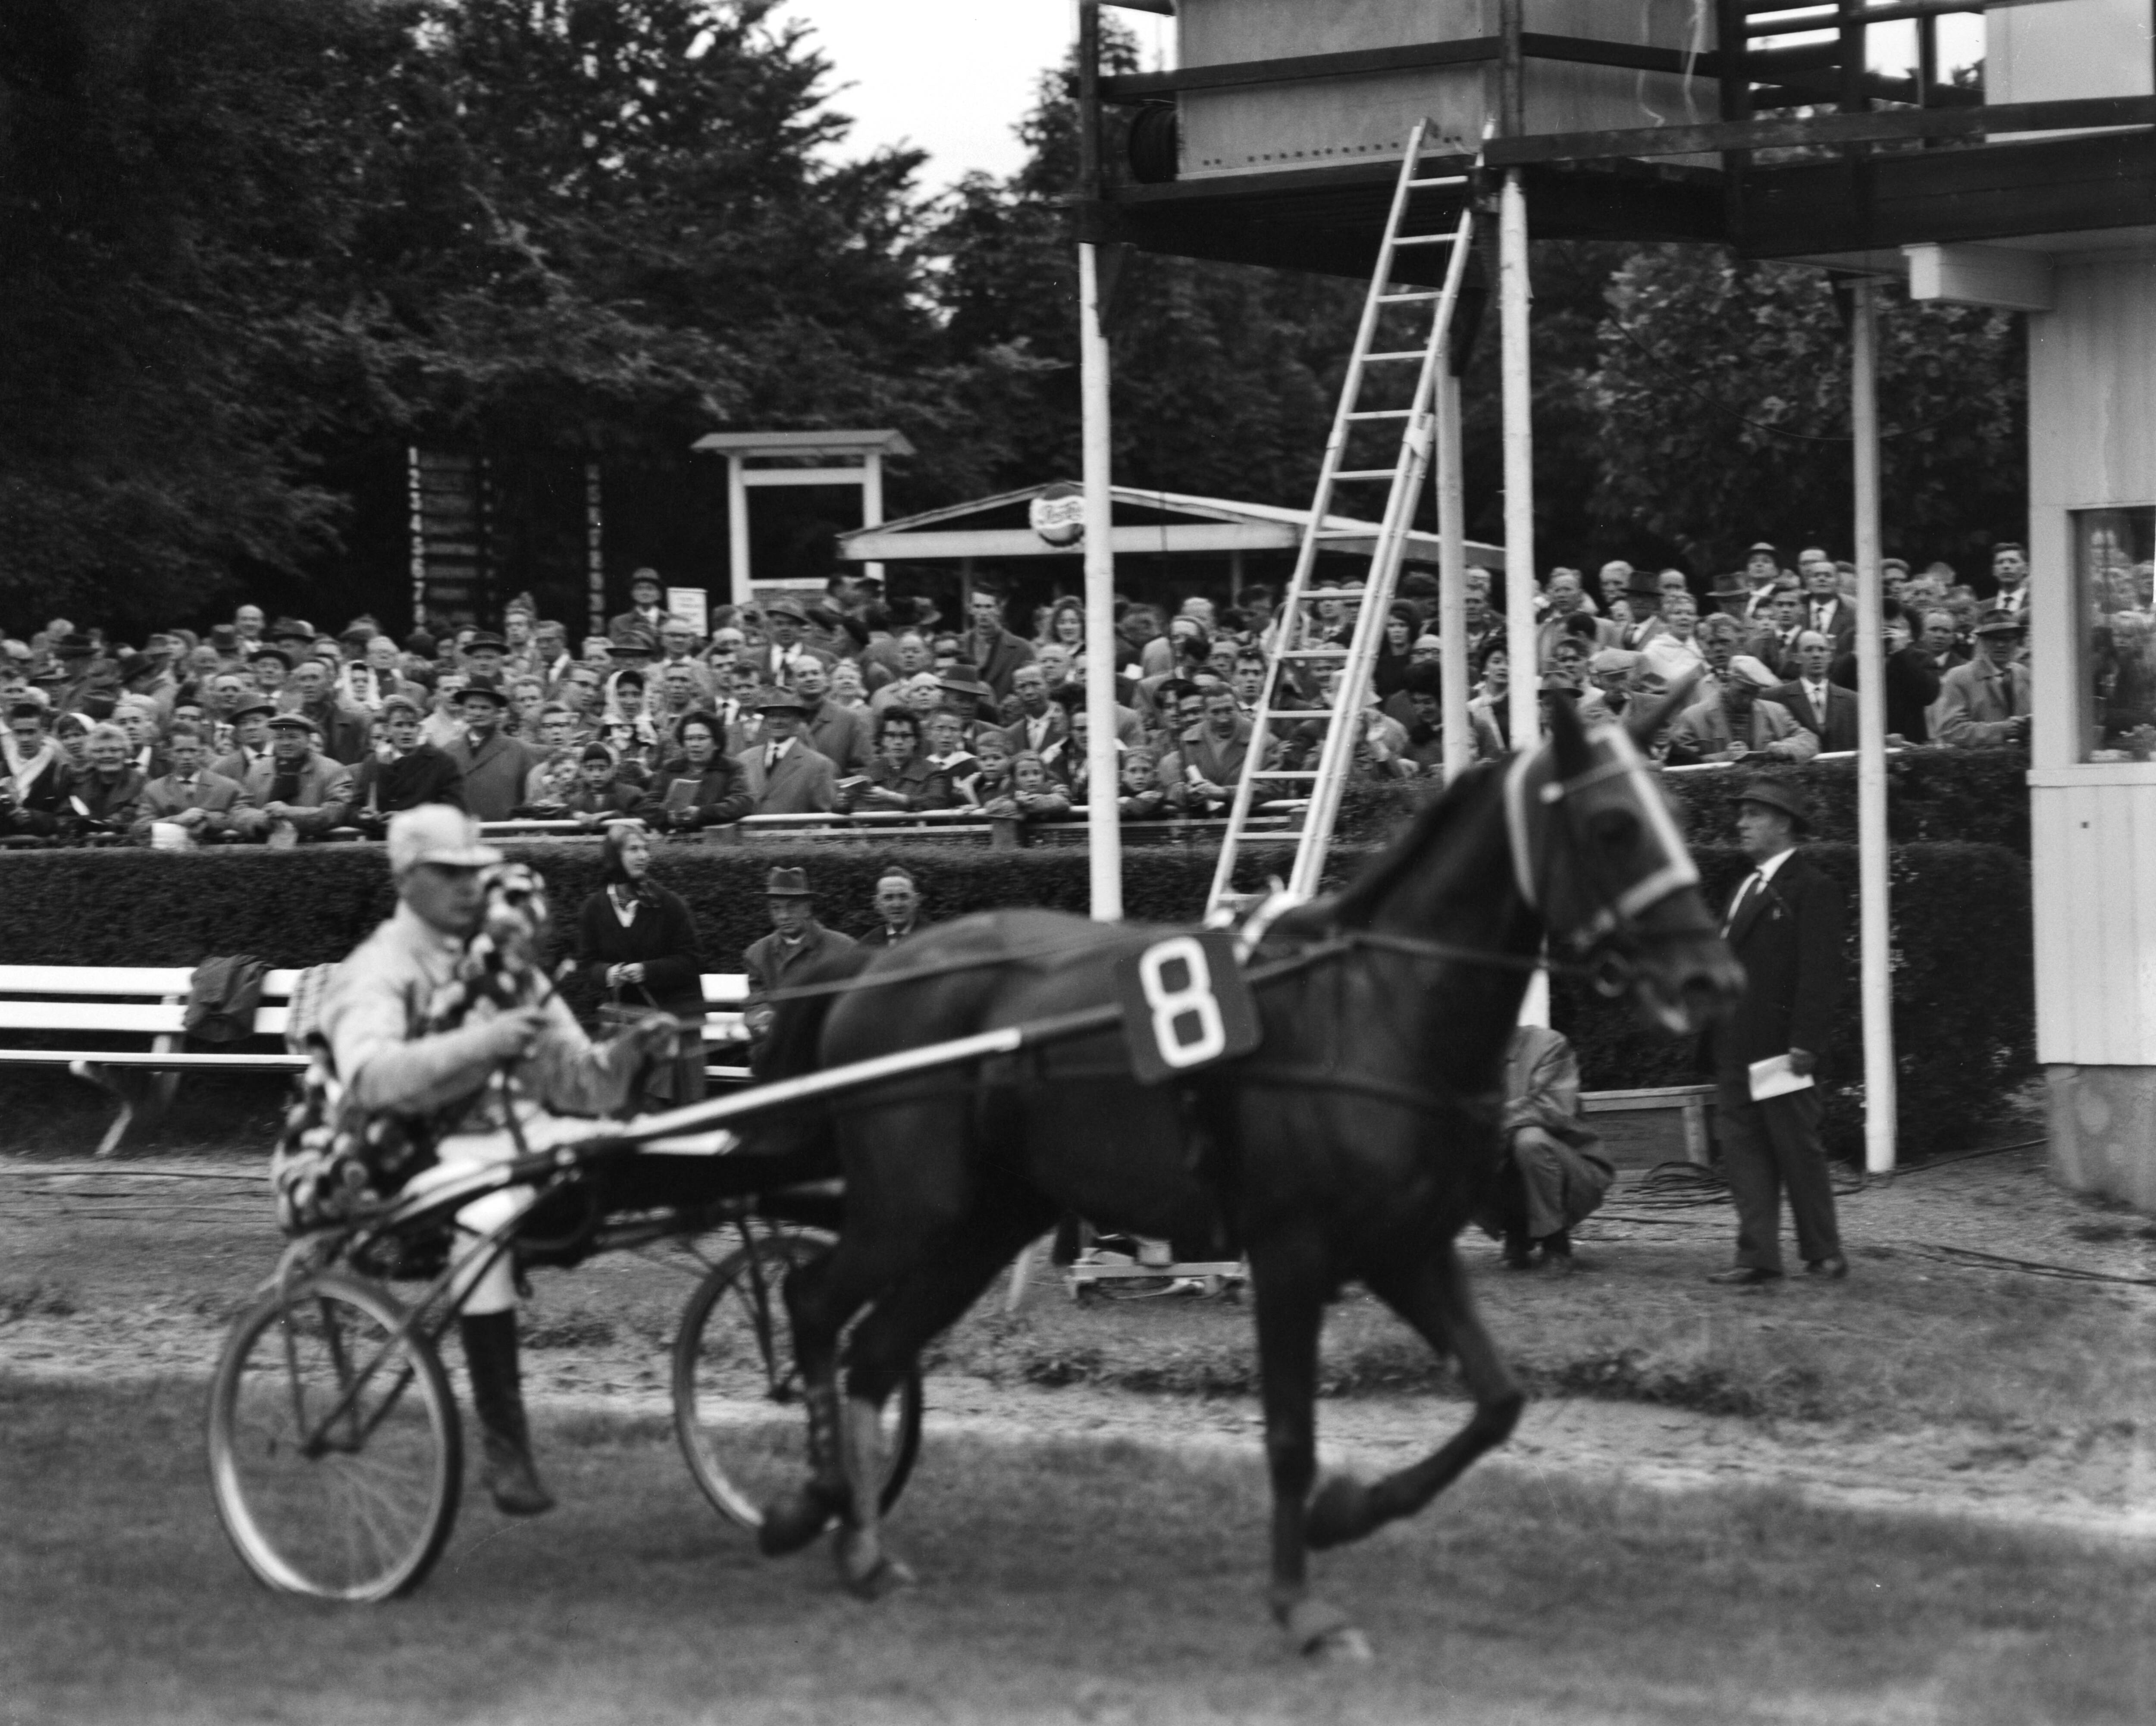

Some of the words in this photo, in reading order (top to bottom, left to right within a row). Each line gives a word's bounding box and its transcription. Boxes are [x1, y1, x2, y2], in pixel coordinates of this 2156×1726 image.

[409, 468, 420, 489] 2
[410, 491, 422, 511] 3
[413, 580, 425, 601] 7
[1139, 937, 1225, 1068] 8
